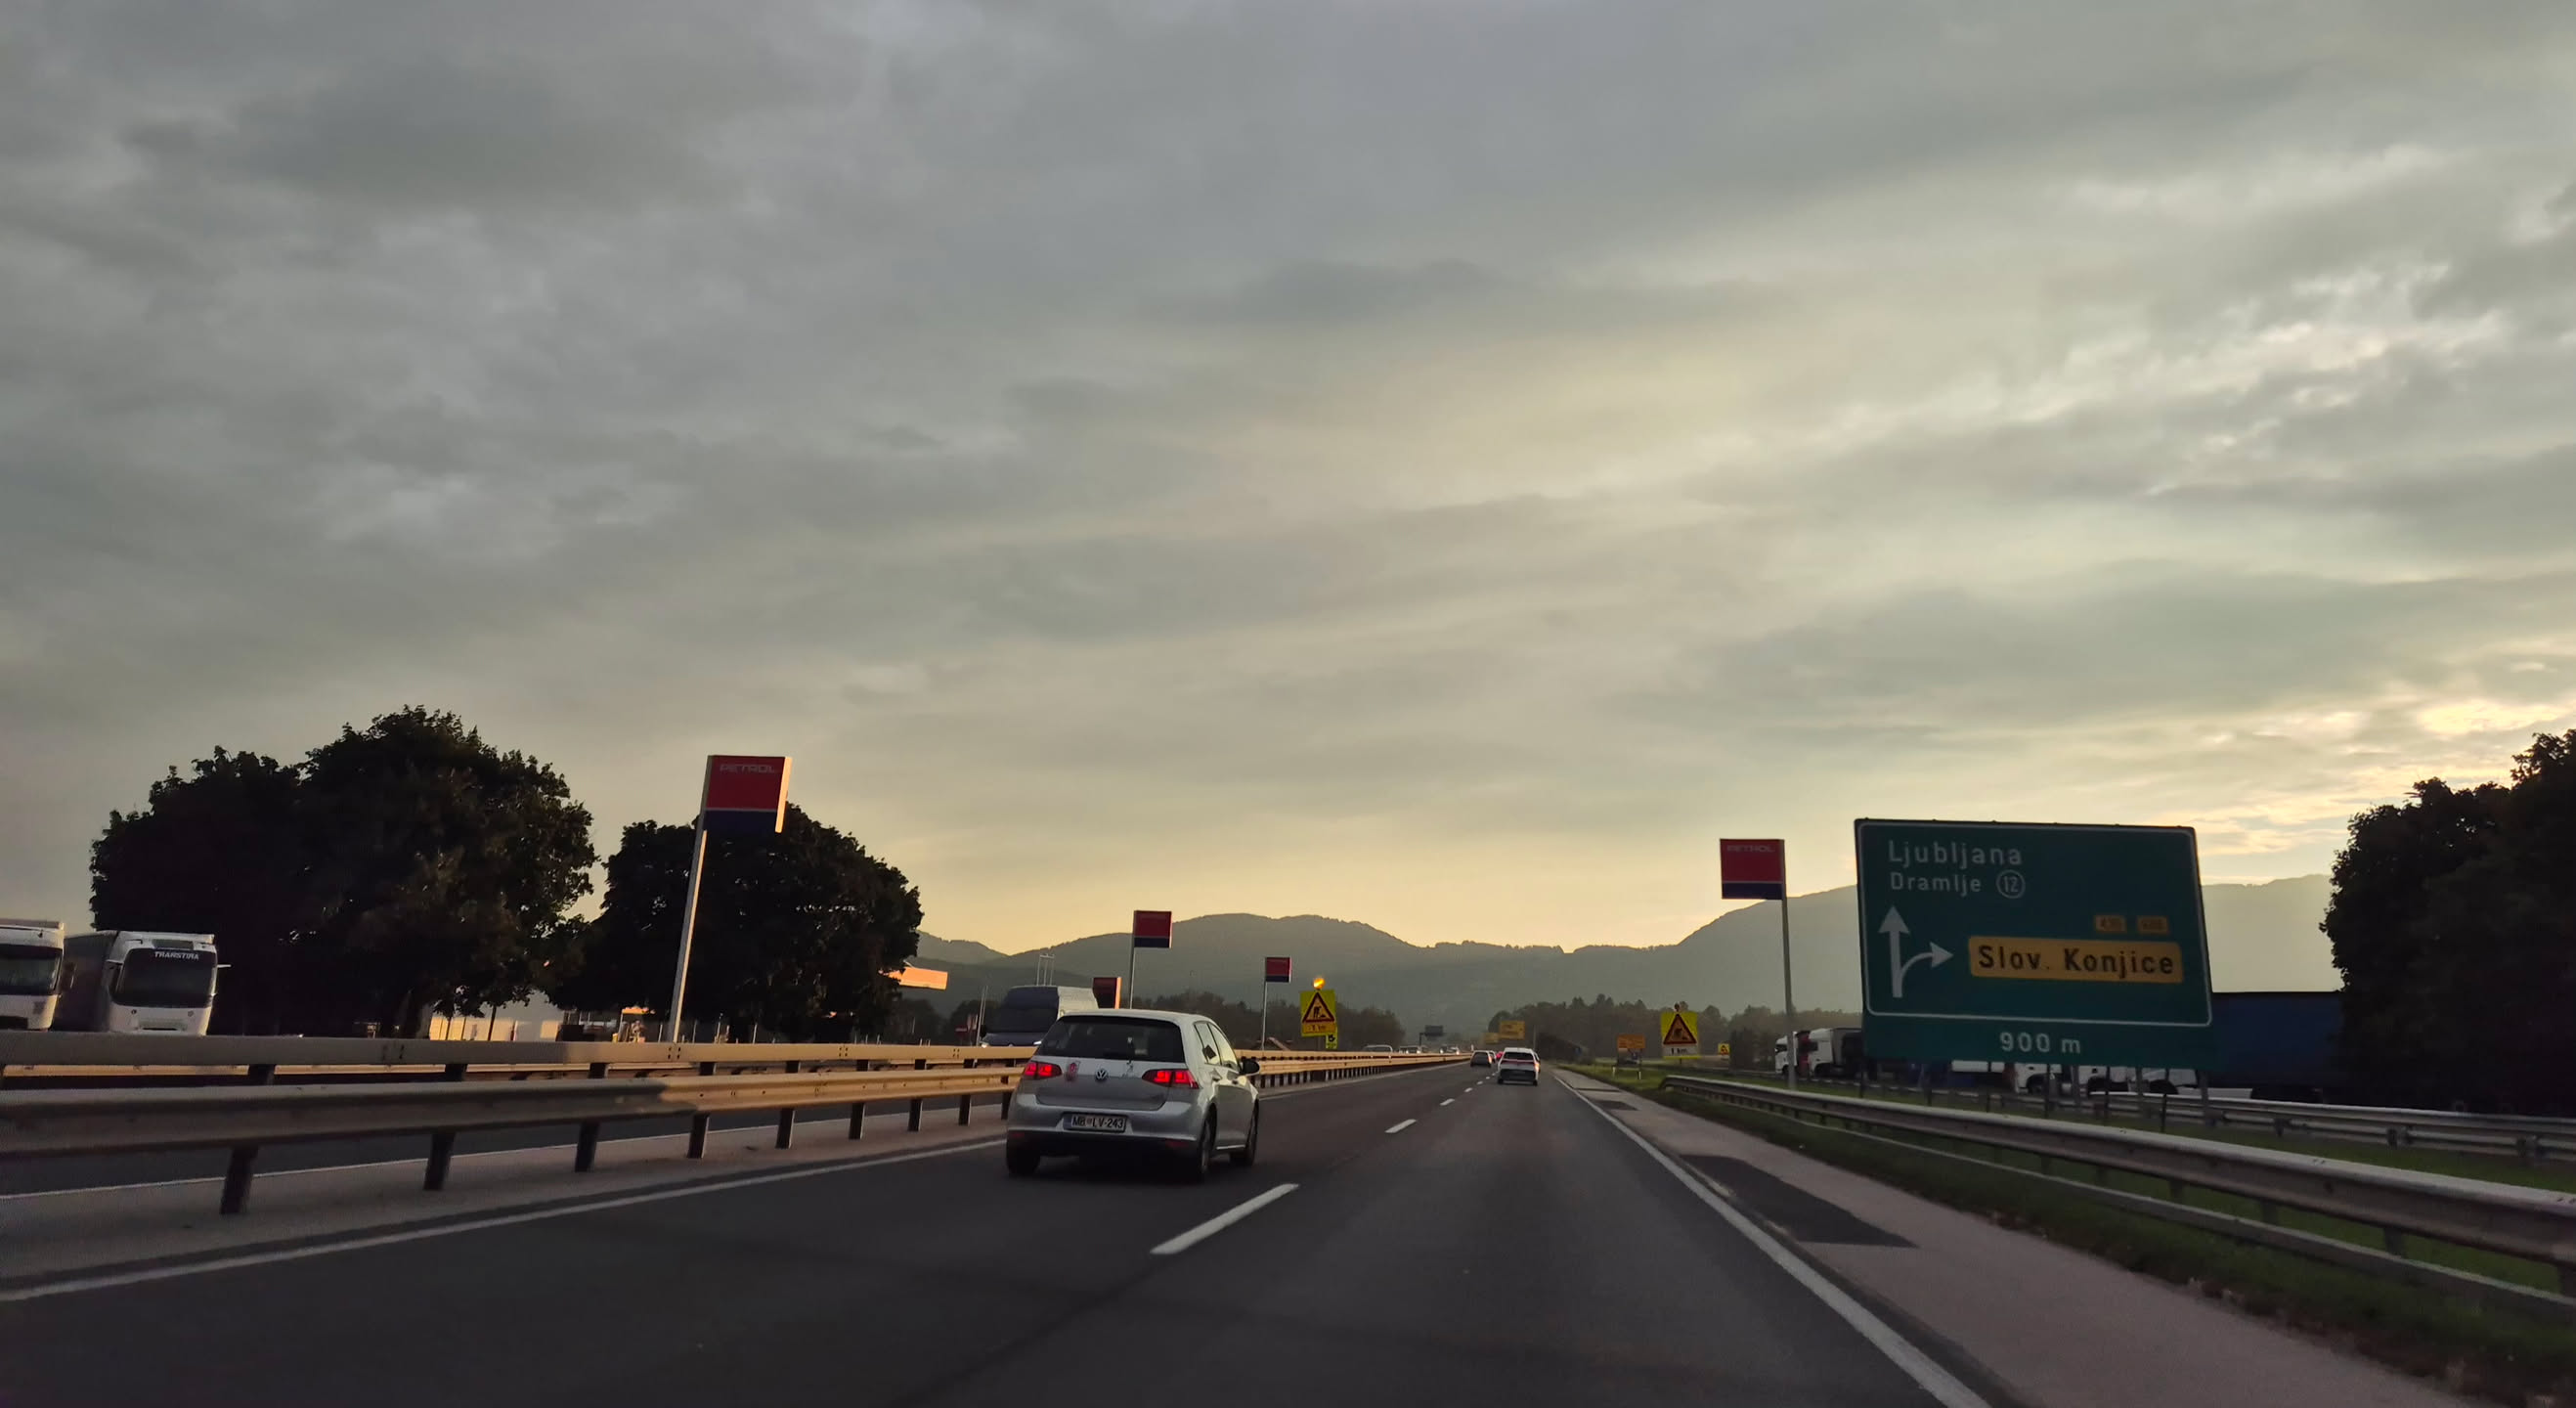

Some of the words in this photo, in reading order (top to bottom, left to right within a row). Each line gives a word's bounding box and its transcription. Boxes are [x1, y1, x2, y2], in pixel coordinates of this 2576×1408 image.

[719, 764, 776, 773] PETROL
[1726, 844, 1775, 854] PETROL
[1888, 840, 2023, 869] Ljubljana
[1890, 871, 1982, 897] Dramlje
[2000, 874, 2021, 895] 12
[1979, 945, 2050, 971] Slov.
[2064, 948, 2174, 979] Konjice
[1999, 1032, 2051, 1053] 900
[2061, 1037, 2082, 1054] m
